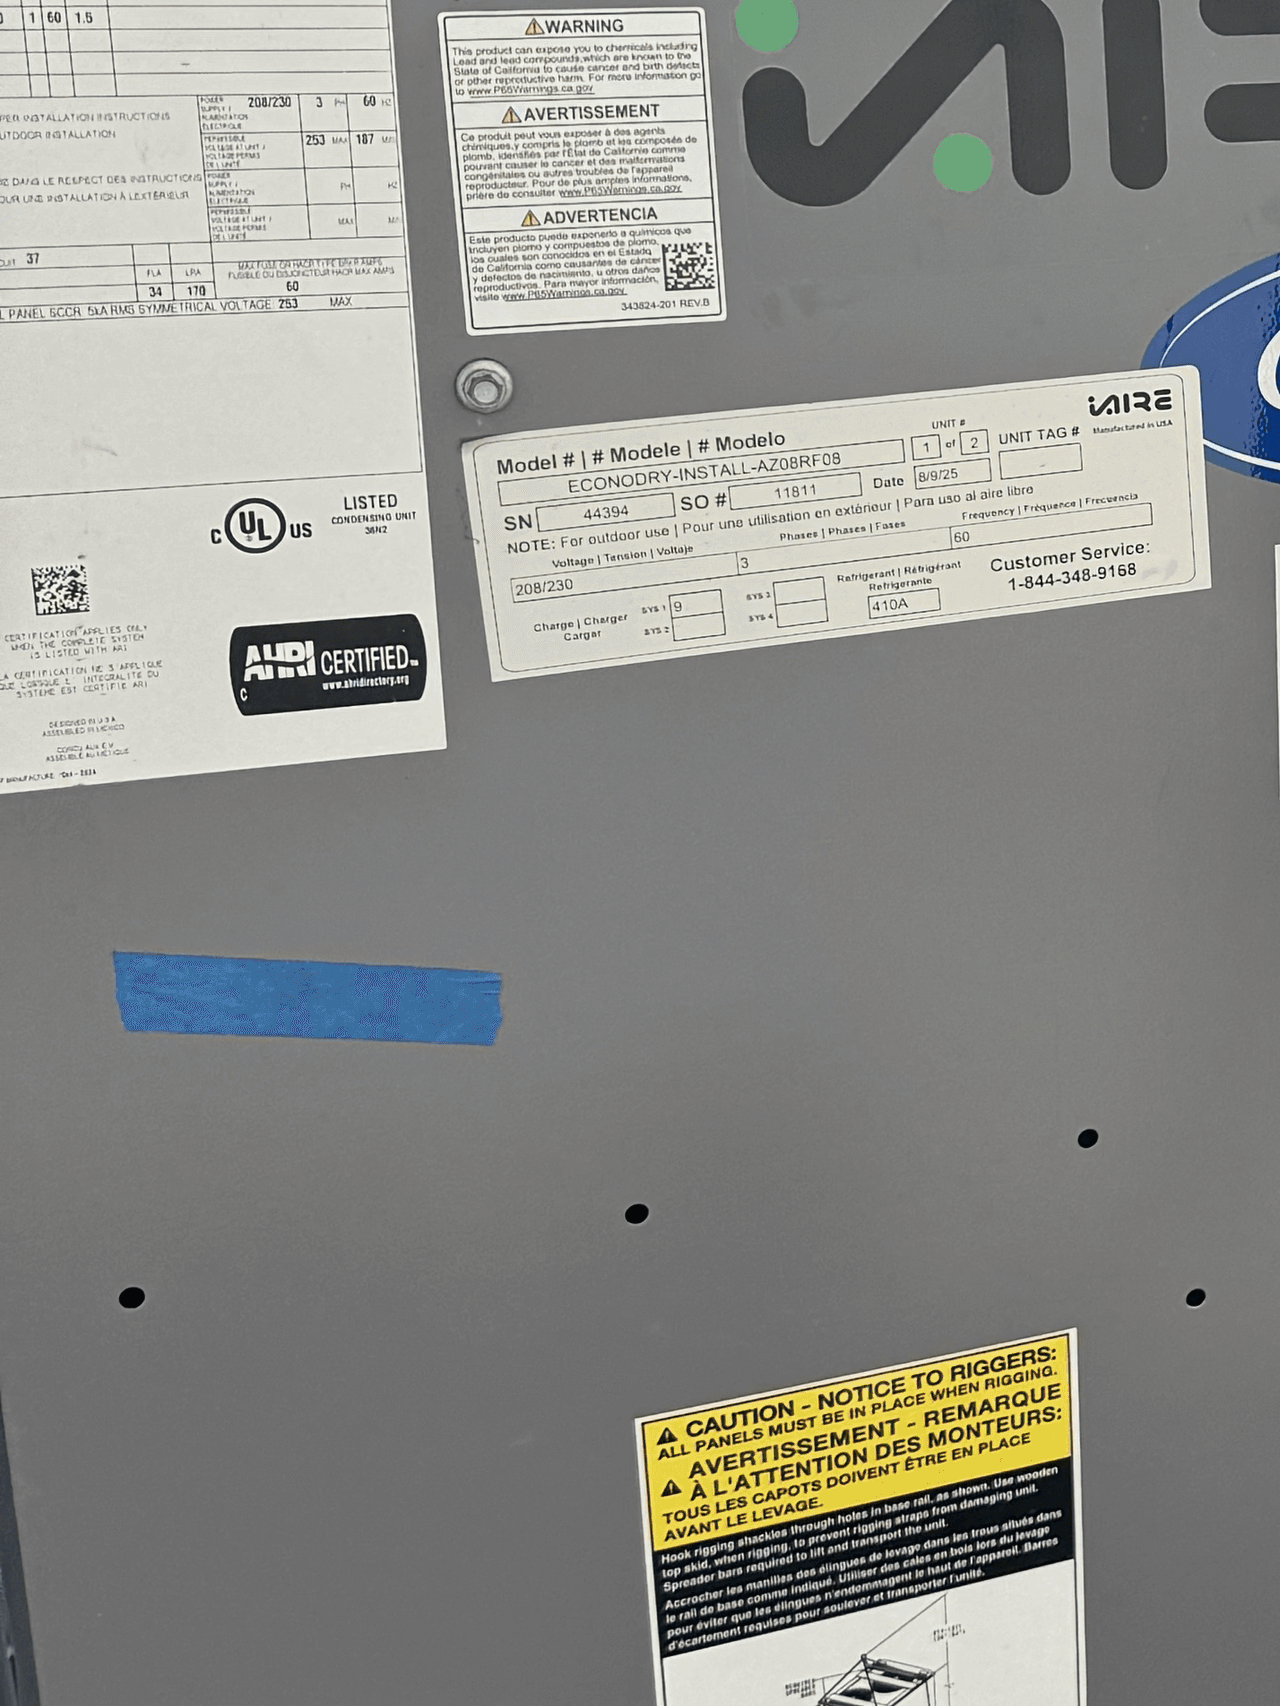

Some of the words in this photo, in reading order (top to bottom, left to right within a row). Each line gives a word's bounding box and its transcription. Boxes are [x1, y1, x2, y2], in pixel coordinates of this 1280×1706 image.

[545, 19, 624, 33] WARNING
[524, 103, 660, 122] AVERTISSEMENT
[543, 207, 658, 224] ADVERTENCIA
[220, 298, 271, 311] VOLTAGE
[931, 419, 957, 430] UNIT
[998, 430, 1032, 446] UNIT
[1036, 427, 1068, 442] TAG
[1071, 425, 1081, 437] #
[497, 455, 558, 476] Model
[563, 452, 576, 467] #
[592, 449, 605, 465] #
[610, 442, 682, 464] Modele
[698, 437, 711, 453] #
[715, 431, 786, 453] Modelo
[970, 436, 979, 449] 2
[568, 451, 842, 494] ECONODRY-INSTALL-AZ08RF08
[344, 493, 398, 510] LISTED
[504, 513, 533, 532] SN
[583, 504, 630, 521] 44394
[680, 494, 711, 511] SO
[714, 492, 728, 509] #
[774, 483, 818, 500] 11811
[872, 475, 905, 489] Date
[917, 467, 959, 483] 8/9/25
[290, 522, 312, 539] US
[331, 513, 392, 524] CONDENSING
[395, 511, 417, 521] UNIT
[507, 537, 557, 555] NOTE:
[560, 535, 585, 549] For
[588, 528, 641, 546] outdoor
[645, 526, 670, 540] use
[682, 519, 715, 536] Pour
[719, 517, 744, 531] une
[748, 510, 811, 528] utilisation
[815, 506, 832, 519] en
[835, 500, 892, 518] extérieur
[903, 494, 935, 509] Para
[938, 493, 962, 505] uso
[965, 489, 976, 502] al
[979, 486, 1004, 501] aire
[1006, 483, 1035, 498] libre
[514, 578, 574, 597] 208/230
[740, 557, 750, 569] 3
[953, 530, 971, 544] 60
[552, 554, 595, 570] Voltage
[989, 549, 1076, 573] Customer
[1081, 541, 1151, 562] Service:
[1007, 561, 1138, 592] 1-844-348-9168
[674, 601, 683, 613] 9
[872, 596, 909, 612] 410A
[533, 619, 575, 634] Charge
[243, 640, 317, 682] AHRI
[320, 644, 410, 675] CERTIFIED
[686, 1399, 796, 1439] CAUTION
[817, 1379, 908, 1410] NOTICE
[911, 1369, 944, 1390] TO
[949, 1345, 1058, 1383] RIGGERS:
[657, 1443, 691, 1461] ALL
[695, 1427, 765, 1453] PANELS
[769, 1416, 816, 1438] MUST
[822, 1410, 845, 1426] BE
[849, 1404, 867, 1420] IN
[871, 1394, 926, 1416] PLACE
[931, 1383, 979, 1404] WHEN
[984, 1367, 1059, 1394] RIGGING.
[688, 1418, 901, 1479] AVERTISSEMENT
[923, 1382, 1062, 1429] REMARQUE
[690, 1479, 707, 1502] À
[713, 1449, 868, 1497] L'ATTENTION
[875, 1435, 922, 1461] DES
[927, 1406, 1063, 1451] MONTEURS:
[662, 1505, 712, 1525] TOUS
[715, 1496, 748, 1513] LES
[753, 1478, 822, 1506] CAPOTS
[826, 1462, 899, 1489] DOIVENT
[904, 1450, 948, 1472] ÊTRE
[951, 1445, 974, 1461] EN
[977, 1431, 1032, 1454] PLACE
[664, 1519, 722, 1544] AVANT
[726, 1513, 748, 1529] LE
[752, 1494, 825, 1523] LEVAGE.
[661, 1548, 691, 1565] Hook
[693, 1540, 735, 1563] rigging
[738, 1527, 788, 1551] shackles
[790, 1516, 834, 1539] through
[837, 1509, 868, 1528] holes
